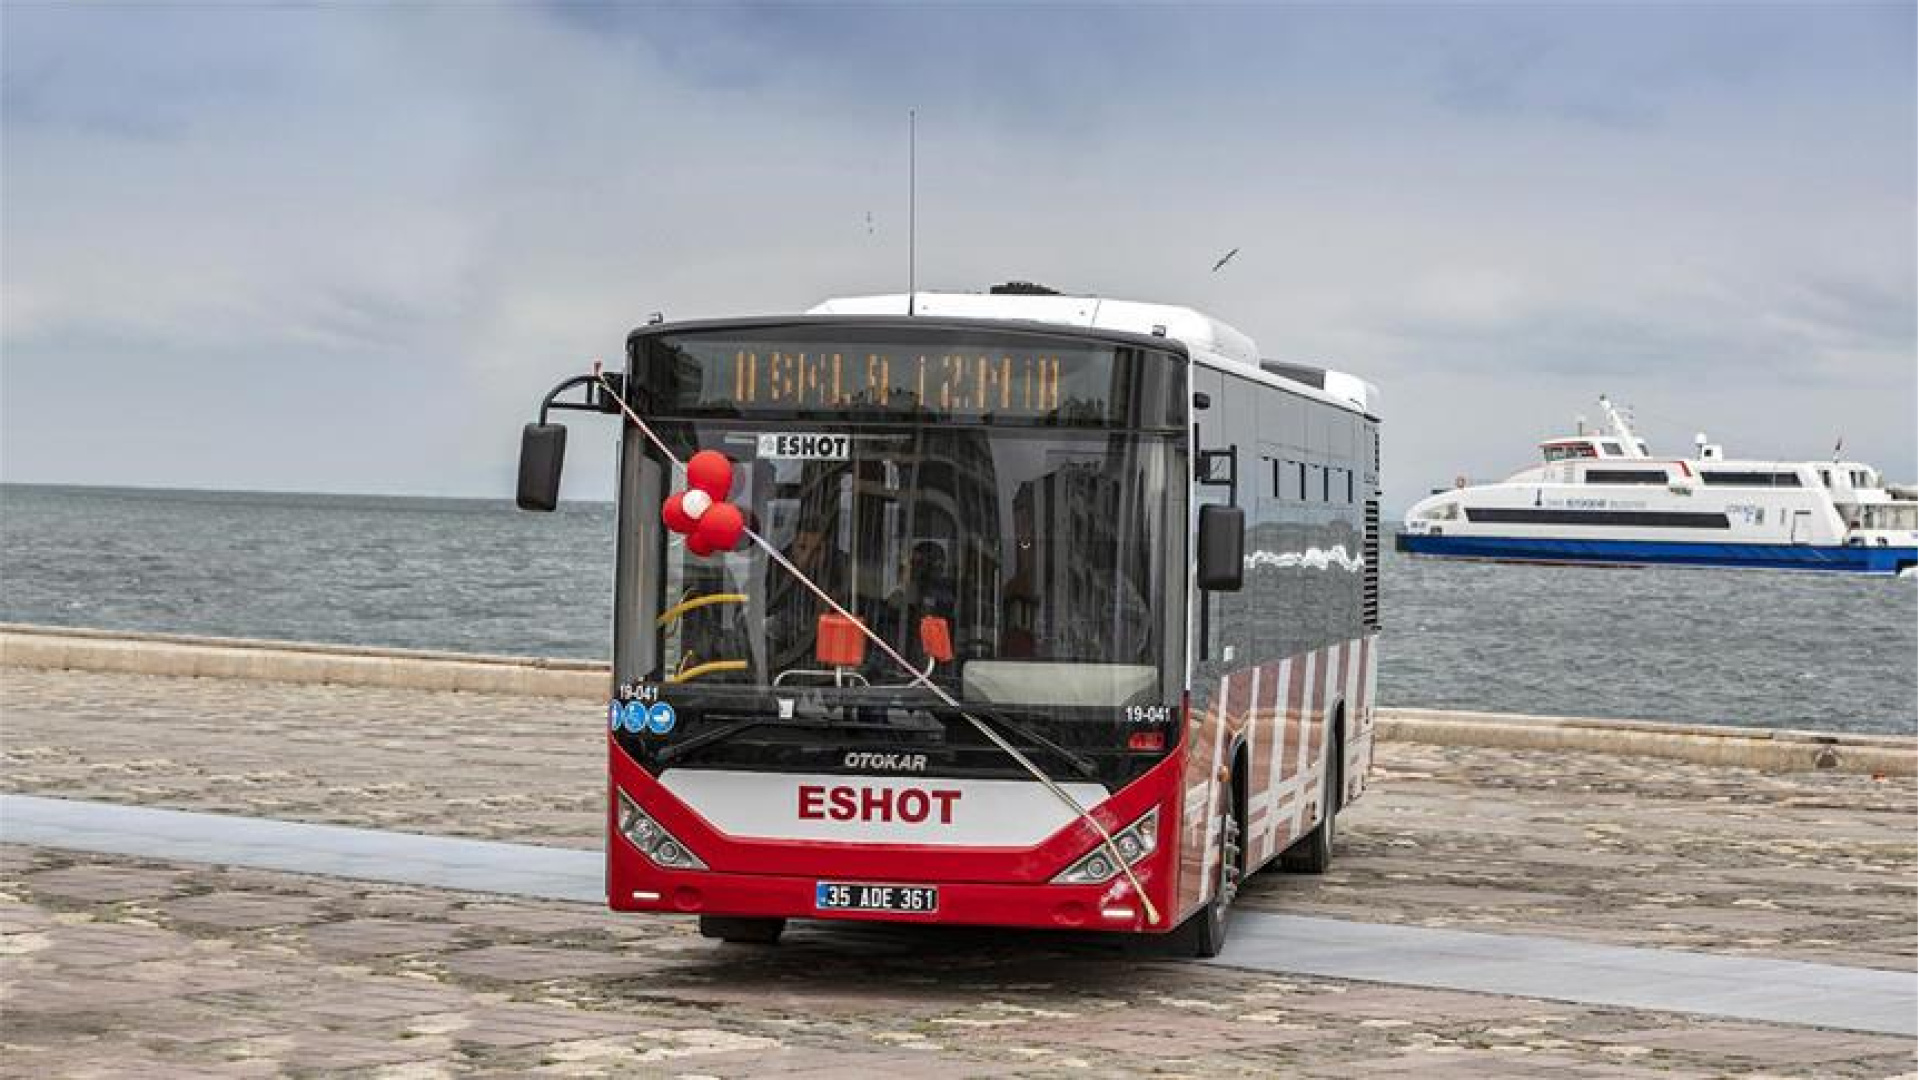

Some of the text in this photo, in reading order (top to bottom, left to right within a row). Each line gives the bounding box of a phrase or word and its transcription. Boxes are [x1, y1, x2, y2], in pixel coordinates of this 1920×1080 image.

[777, 436, 846, 457] ESHOT
[620, 685, 658, 701] 19-041
[1126, 706, 1170, 723] 19-041
[844, 752, 928, 771] OTOKAR
[798, 786, 962, 825] ESHOT
[828, 886, 933, 910] 35 ADE 361
